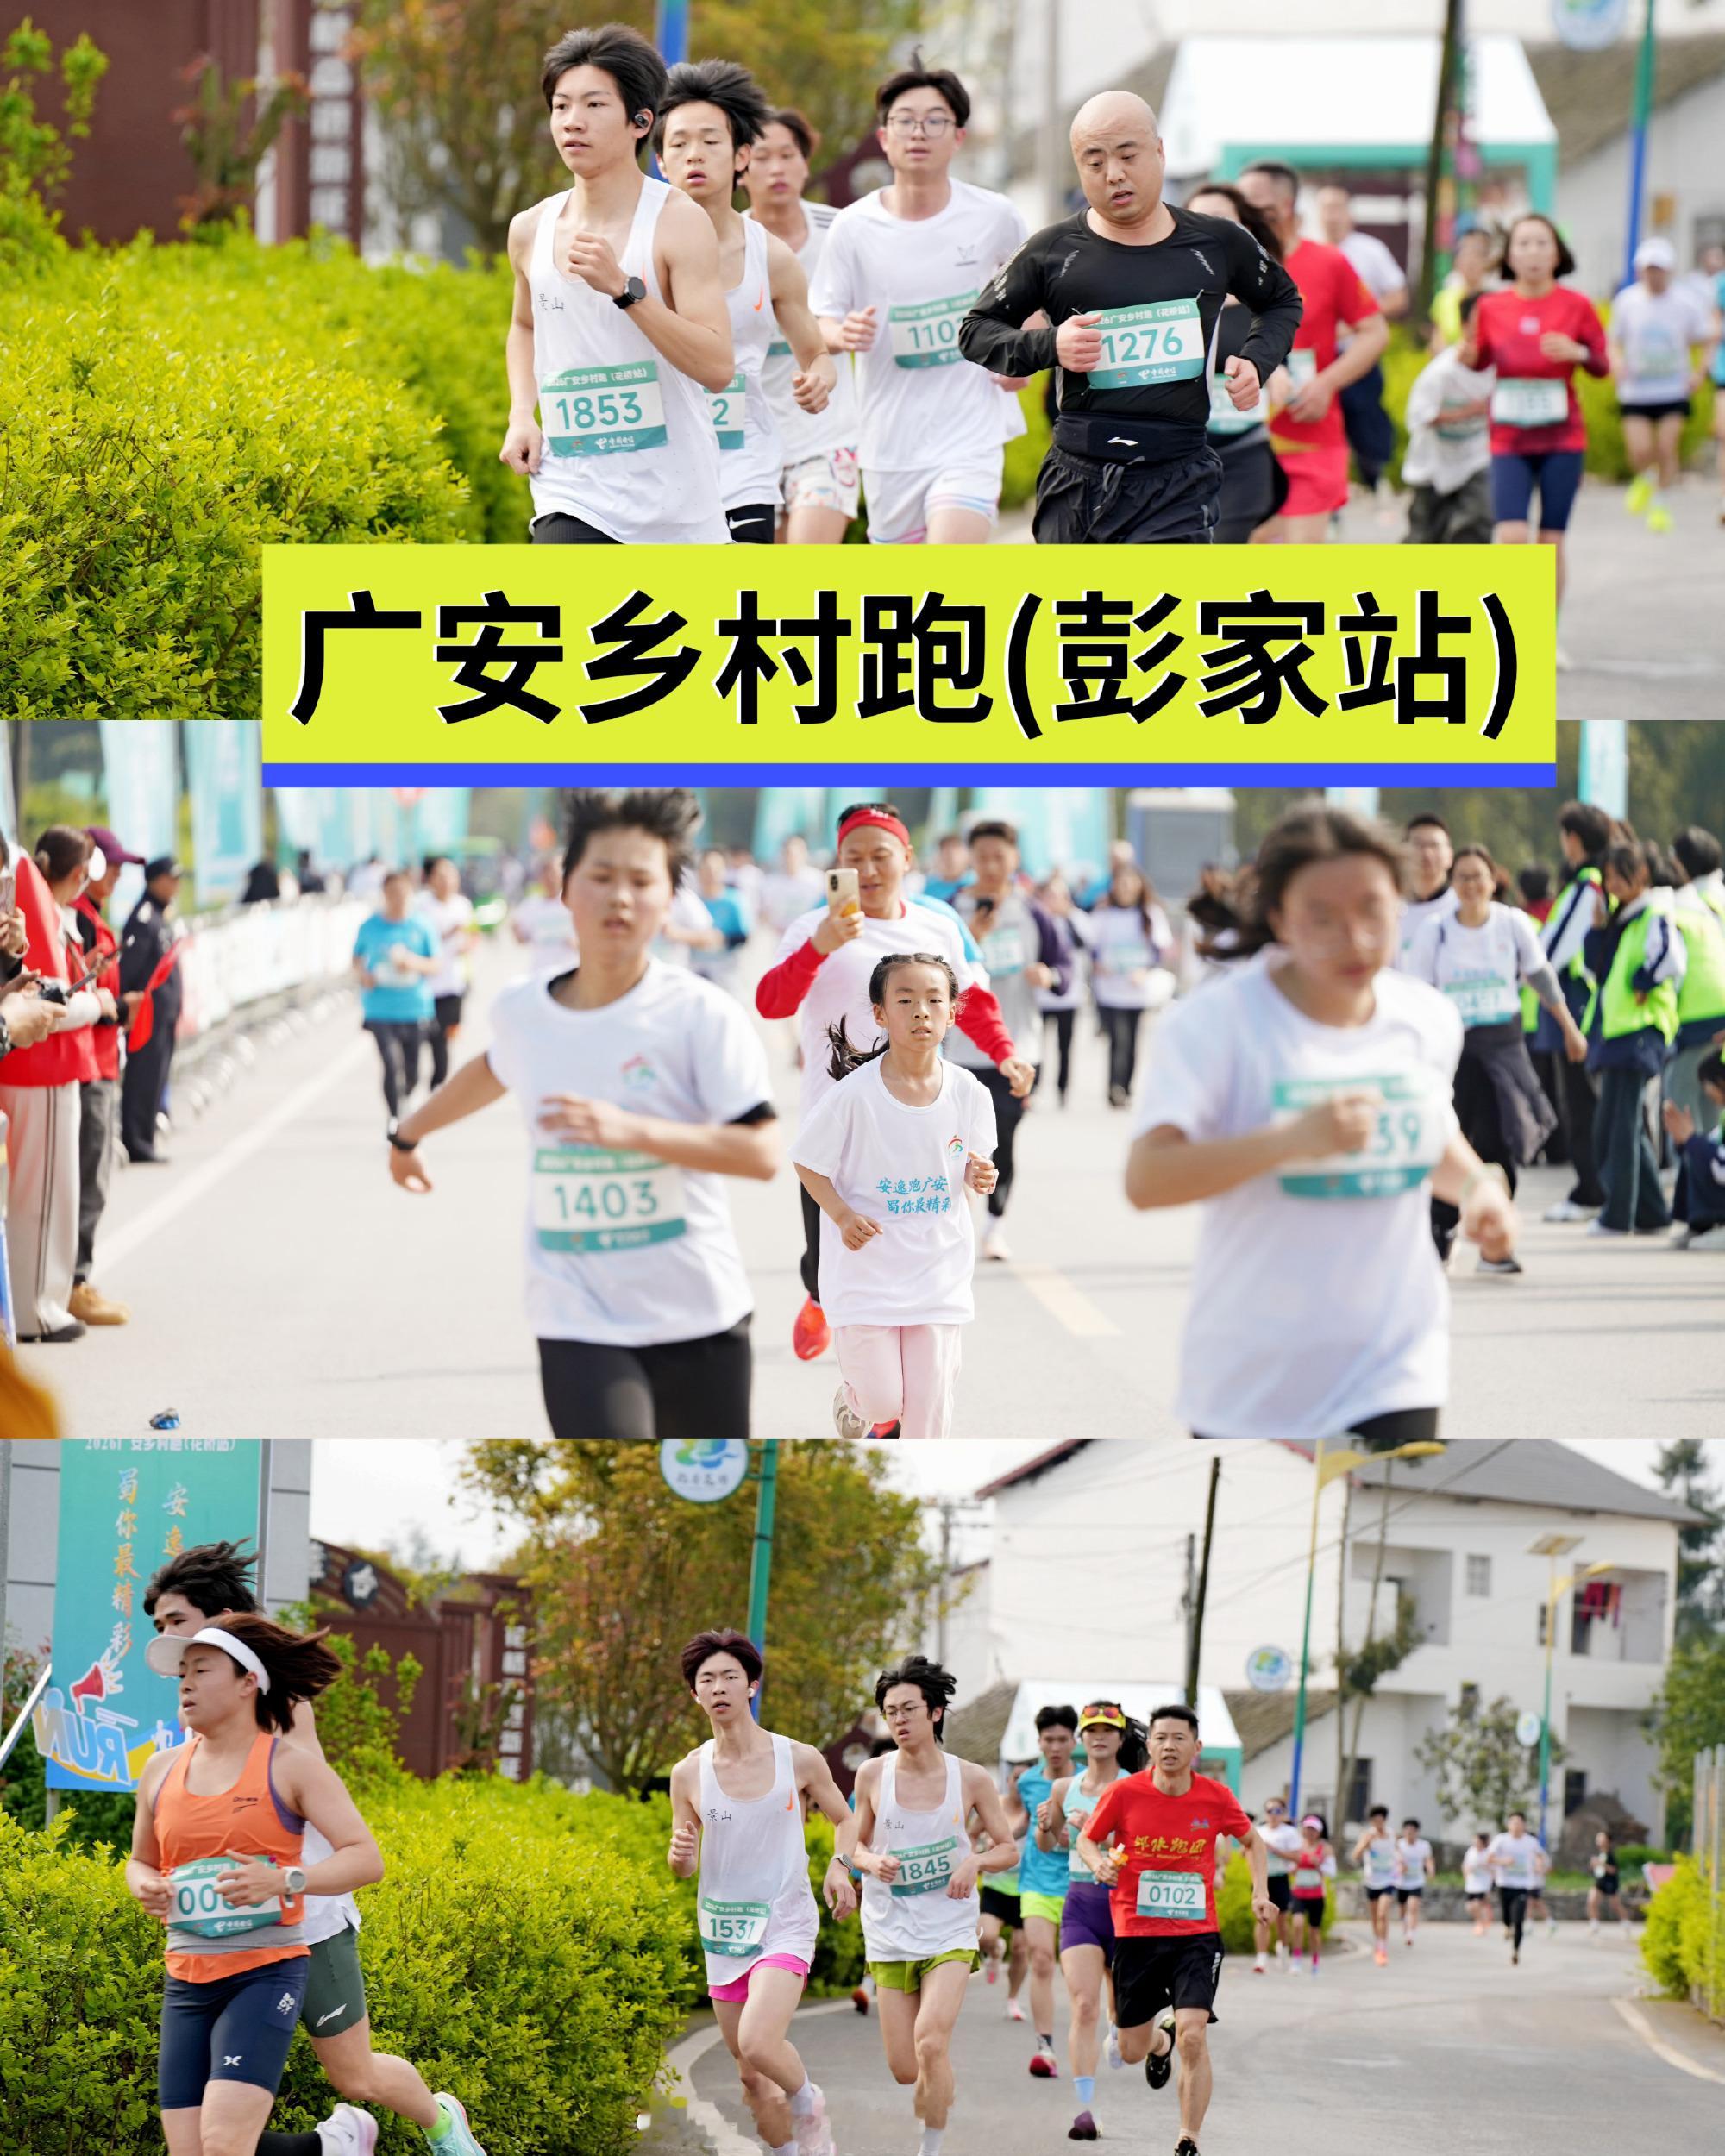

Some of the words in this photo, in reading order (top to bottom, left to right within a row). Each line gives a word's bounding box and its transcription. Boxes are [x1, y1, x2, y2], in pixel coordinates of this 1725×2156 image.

[907, 316, 963, 349] 110
[1101, 326, 1183, 364] 1276
[556, 392, 643, 430] 1853
[553, 1181, 659, 1220] 1403
[875, 1175, 949, 1195] 安逸跑广安
[887, 1194, 952, 1215] 蜀你最精彩
[112, 1467, 141, 1658] 蜀你最精彩
[706, 1808, 732, 1823] 景山
[897, 1854, 950, 1882] 1845
[178, 1883, 264, 1915] 00
[1149, 1885, 1196, 1905] 0102
